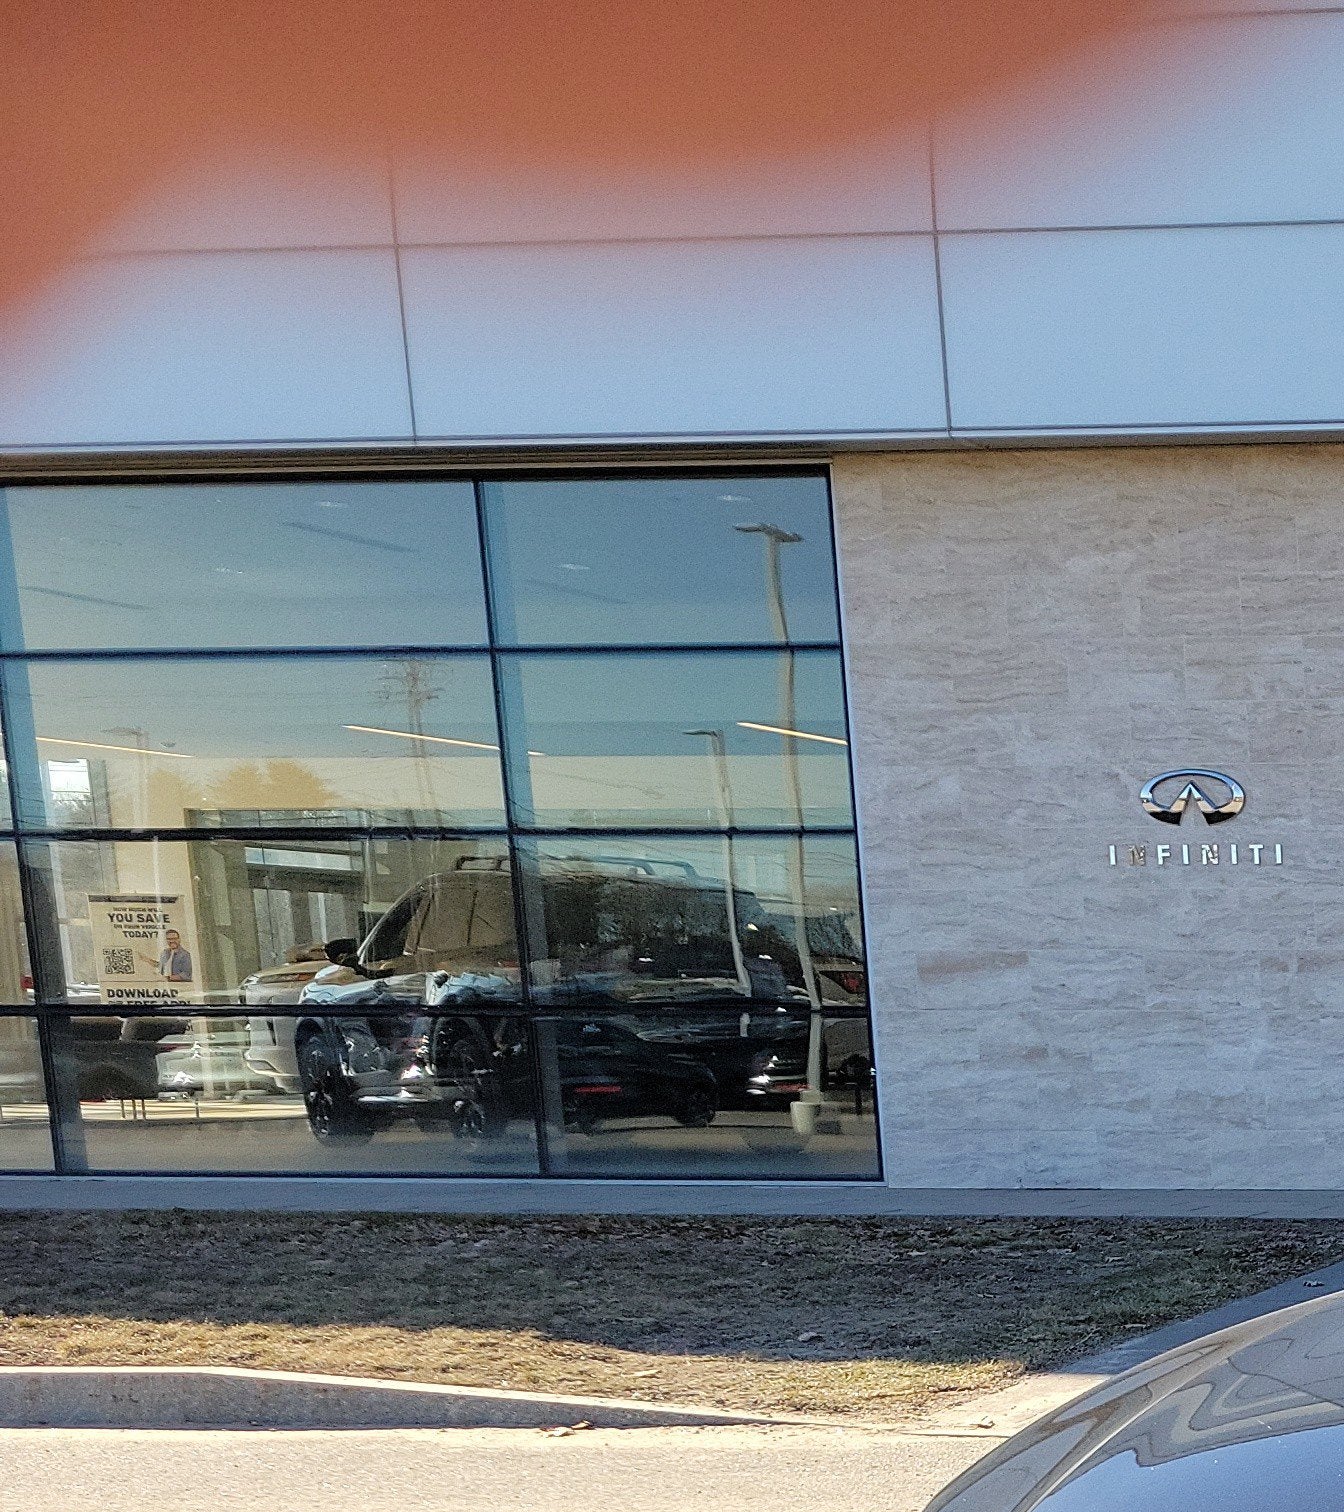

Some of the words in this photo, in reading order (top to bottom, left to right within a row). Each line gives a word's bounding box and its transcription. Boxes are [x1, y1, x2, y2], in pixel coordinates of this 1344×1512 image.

[1107, 843, 1283, 866] INFINITI
[107, 913, 133, 923] YOU
[136, 913, 171, 924] SAVE
[122, 930, 159, 939] TODAY?
[106, 988, 179, 999] DOWNLOAD
